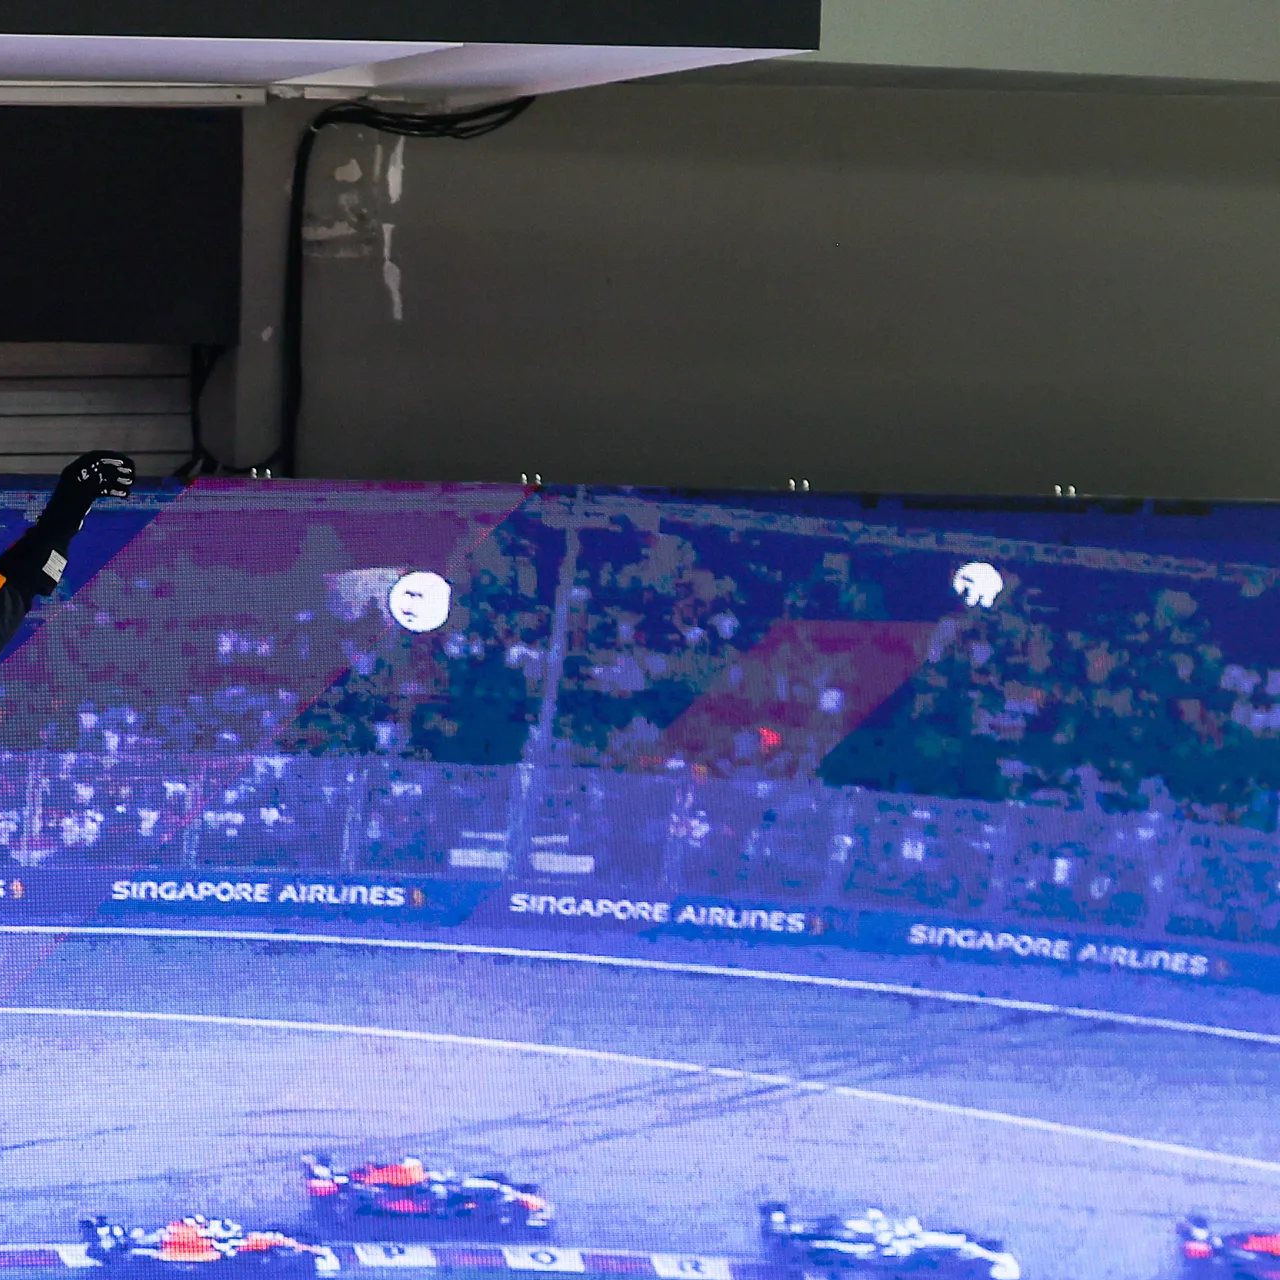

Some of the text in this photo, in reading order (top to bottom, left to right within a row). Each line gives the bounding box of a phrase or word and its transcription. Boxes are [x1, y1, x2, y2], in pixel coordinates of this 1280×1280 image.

[112, 880, 405, 907] SINGAPORE AIRLINES
[509, 892, 806, 934] SINGAPORE AIRLINES
[908, 923, 1210, 978] SINGAPORE AIRLINES
